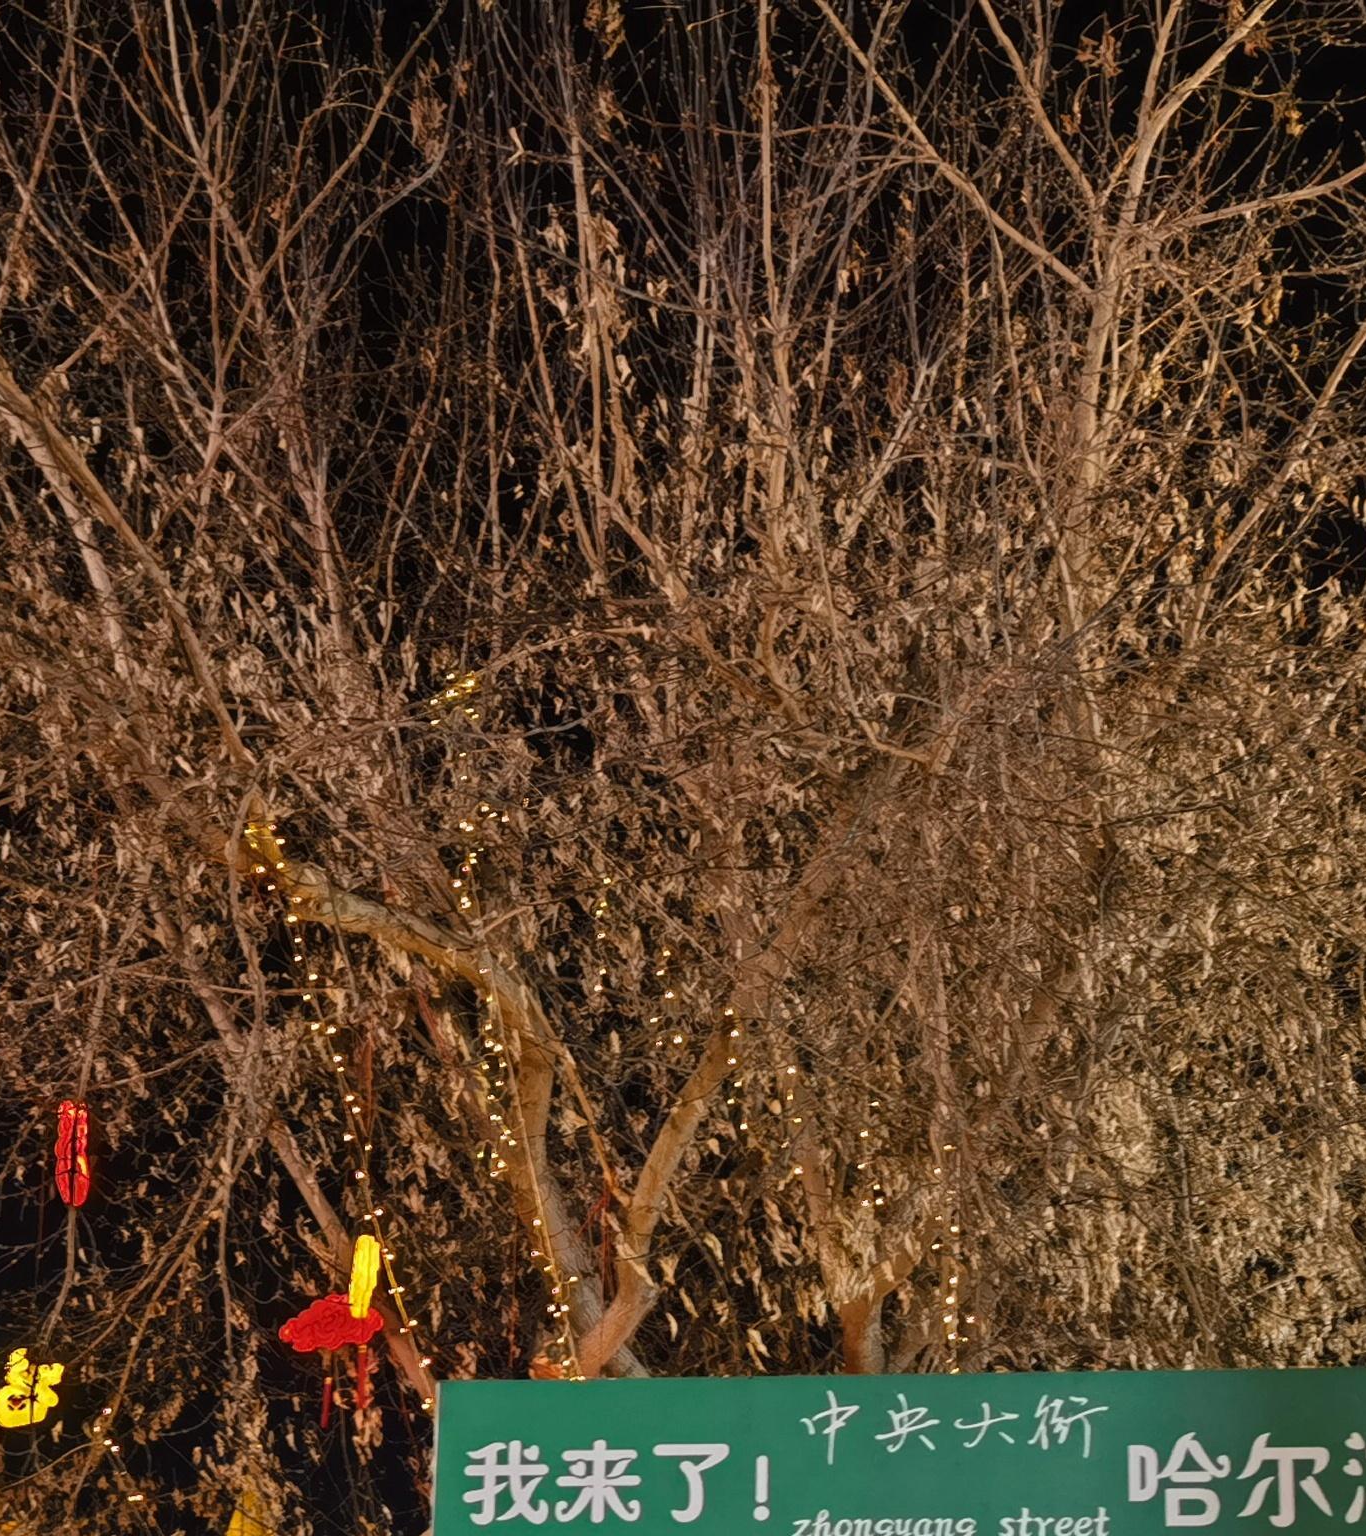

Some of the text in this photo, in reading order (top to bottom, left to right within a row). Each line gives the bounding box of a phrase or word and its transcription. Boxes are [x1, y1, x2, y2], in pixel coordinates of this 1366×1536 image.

[799, 1389, 1109, 1465] 中央大街
[462, 1439, 771, 1526] 我来了!
